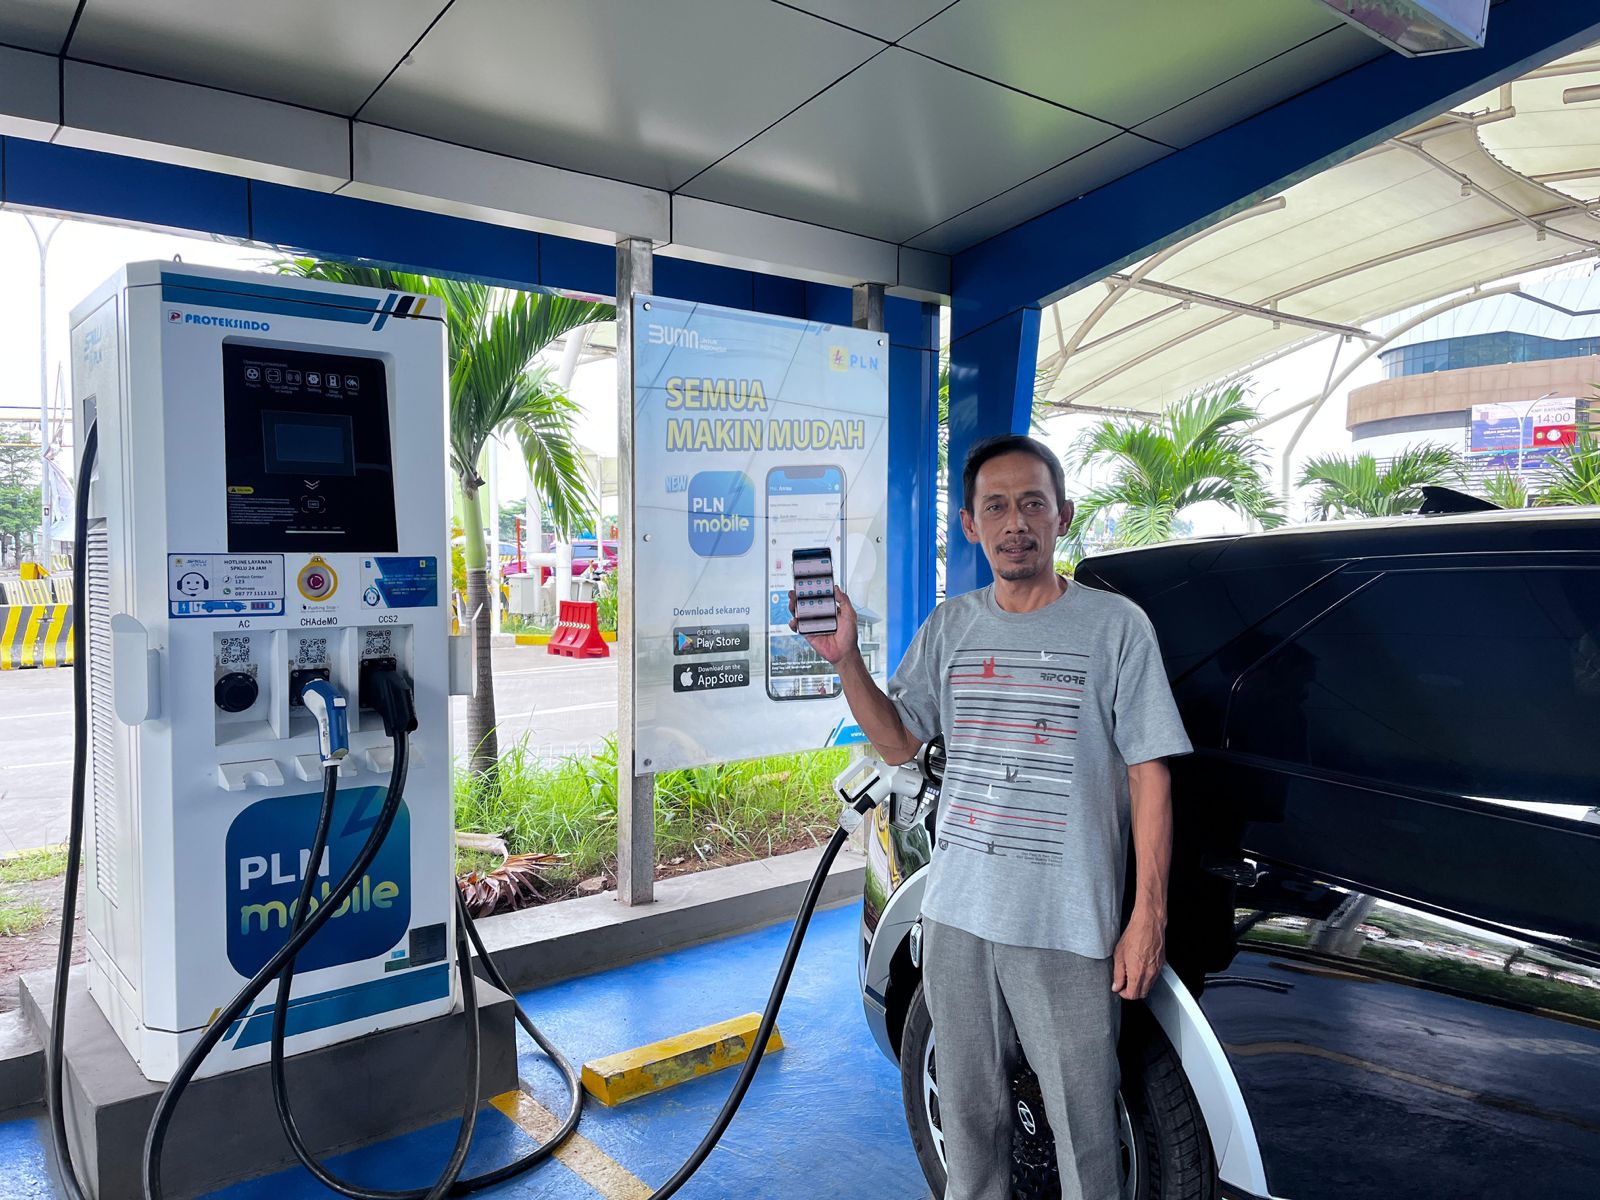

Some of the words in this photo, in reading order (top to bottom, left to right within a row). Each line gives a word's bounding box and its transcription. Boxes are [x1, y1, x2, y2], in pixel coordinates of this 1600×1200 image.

[185, 313, 270, 332] PROTEKSINDO
[850, 354, 879, 370] PLN
[665, 376, 768, 412] SEMUA
[1537, 413, 1571, 424] 14:00
[666, 418, 763, 453] MAKIN
[768, 419, 865, 451] MUDAH
[664, 475, 688, 493] NEW
[693, 497, 724, 513] PLN
[693, 514, 750, 533] mobile
[378, 615, 399, 624] CCS2
[673, 606, 714, 617] Download
[715, 606, 750, 615] sekarang
[238, 620, 251, 629] AC
[300, 617, 338, 627] CHAdeMO
[696, 637, 715, 650] Play
[715, 636, 741, 647] Store
[697, 665, 723, 673] Download
[697, 674, 718, 688] App
[718, 672, 744, 684] Store
[1040, 672, 1086, 686] RIPCORE
[240, 845, 330, 890] PLN
